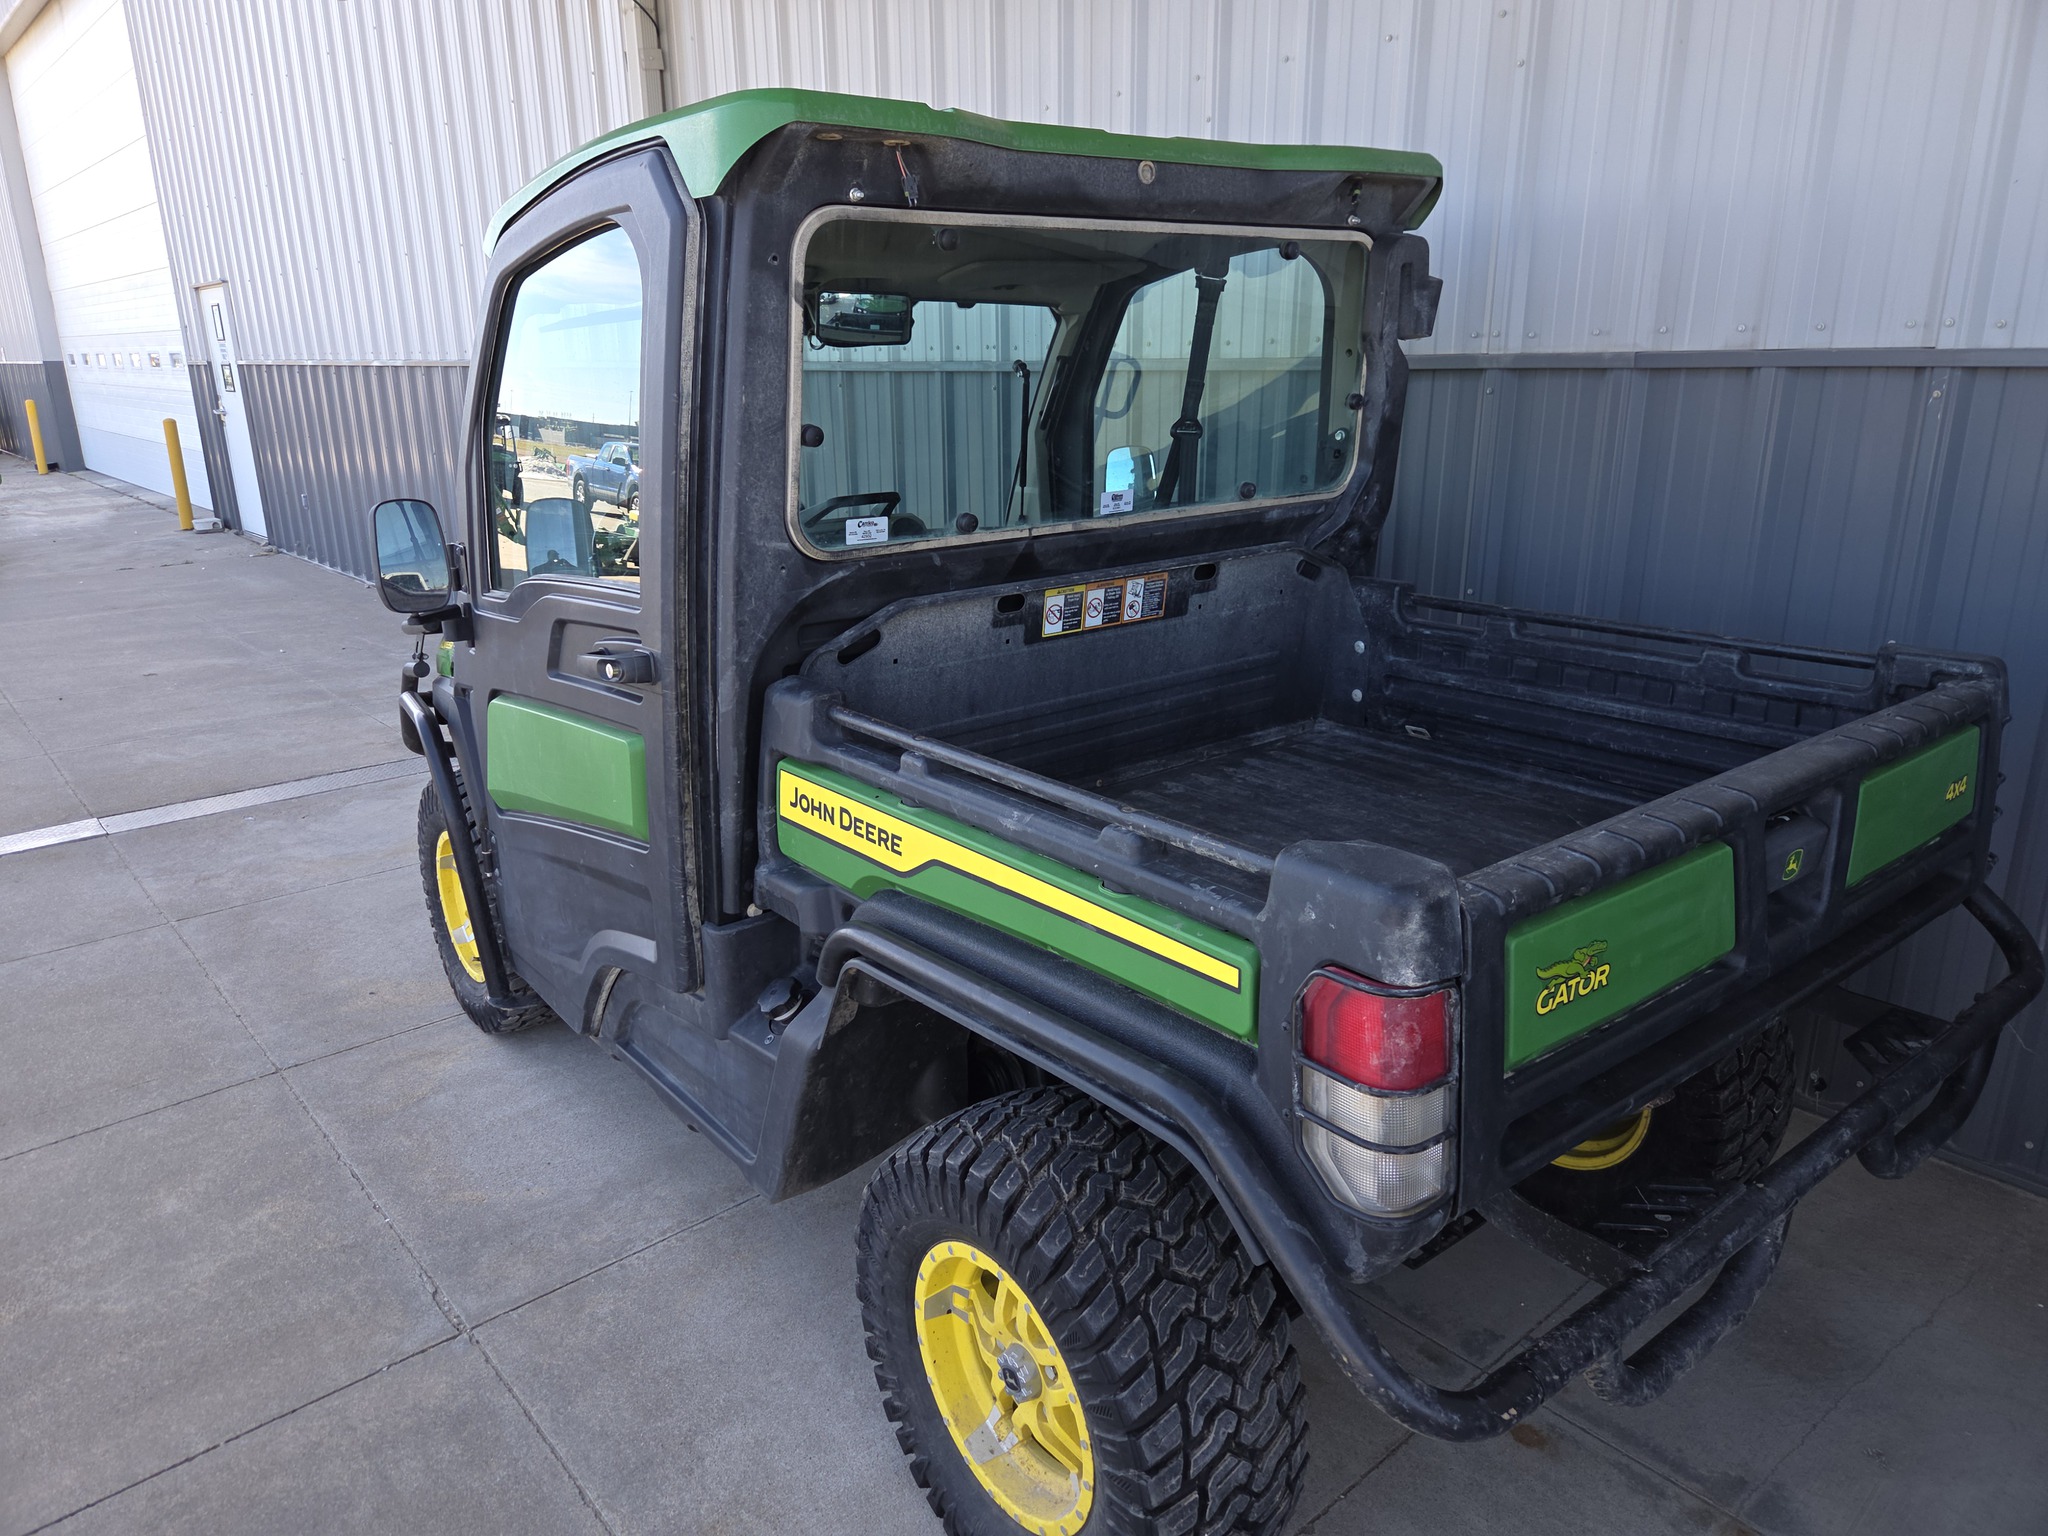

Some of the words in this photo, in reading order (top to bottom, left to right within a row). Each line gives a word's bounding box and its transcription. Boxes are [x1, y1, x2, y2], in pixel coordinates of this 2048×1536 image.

[789, 786, 835, 826] JOHN
[840, 806, 903, 857] DEERE
[1536, 963, 1611, 1016] GATOR
